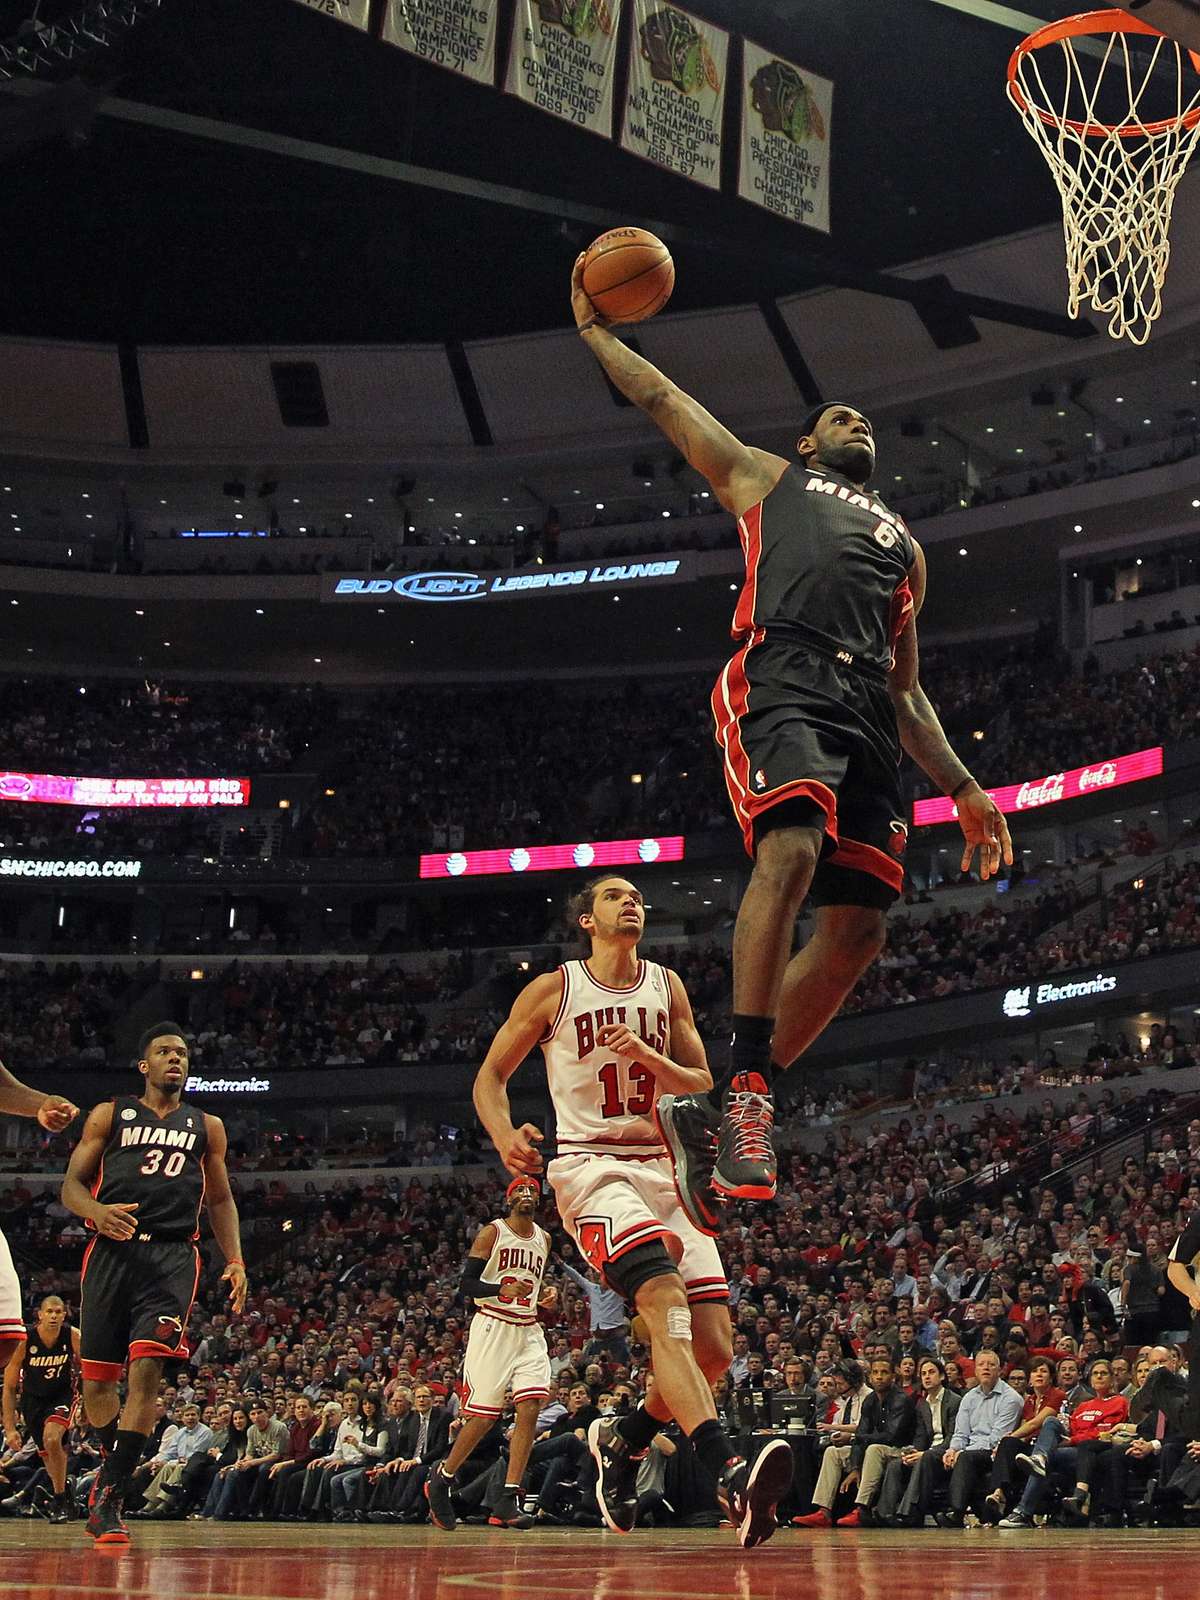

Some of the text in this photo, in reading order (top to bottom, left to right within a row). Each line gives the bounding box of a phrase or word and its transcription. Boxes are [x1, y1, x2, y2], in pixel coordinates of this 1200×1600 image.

[400, 5, 485, 51] CONFERENCE
[404, 19, 478, 62] CHAMPIONS
[540, 23, 591, 57] CHICAGO
[415, 41, 465, 72] 1970-71
[525, 27, 605, 76] BLACKHAWKS
[545, 53, 585, 81] WALES
[522, 57, 602, 104] CONFERENCE
[526, 73, 596, 114] CHAMPIONS
[652, 81, 700, 112] CHICAGO
[534, 91, 586, 124] 1969-70
[640, 87, 713, 131] BLACKHAWKS
[646, 117, 701, 151] PRINCE OF
[656, 110, 720, 146] CHAMPIONS
[630, 122, 716, 171] WALES TROPHY
[646, 145, 695, 175] 1966-67
[750, 136, 820, 178] BLACKHAWKS
[763, 130, 808, 160] CHICAGO
[754, 176, 814, 213] CHAMPIONS
[764, 168, 804, 197] TROPHY
[805, 477, 905, 534] MIAMI
[873, 521, 899, 549] 6
[334, 560, 680, 594] BUD LIGHT LEGENDS LOUNGE
[210, 792, 244, 805] SALE
[0, 859, 141, 877] SNCHICAGO.COM
[1036, 974, 1117, 1004] Electronics
[184, 1076, 271, 1092] Electronics
[598, 1061, 656, 1119] 13
[121, 1126, 197, 1151] MIAMI
[141, 1149, 186, 1177] 30
[498, 1248, 543, 1280] BULLS
[29, 1353, 69, 1367] MIAMI
[43, 1366, 63, 1380] 31
